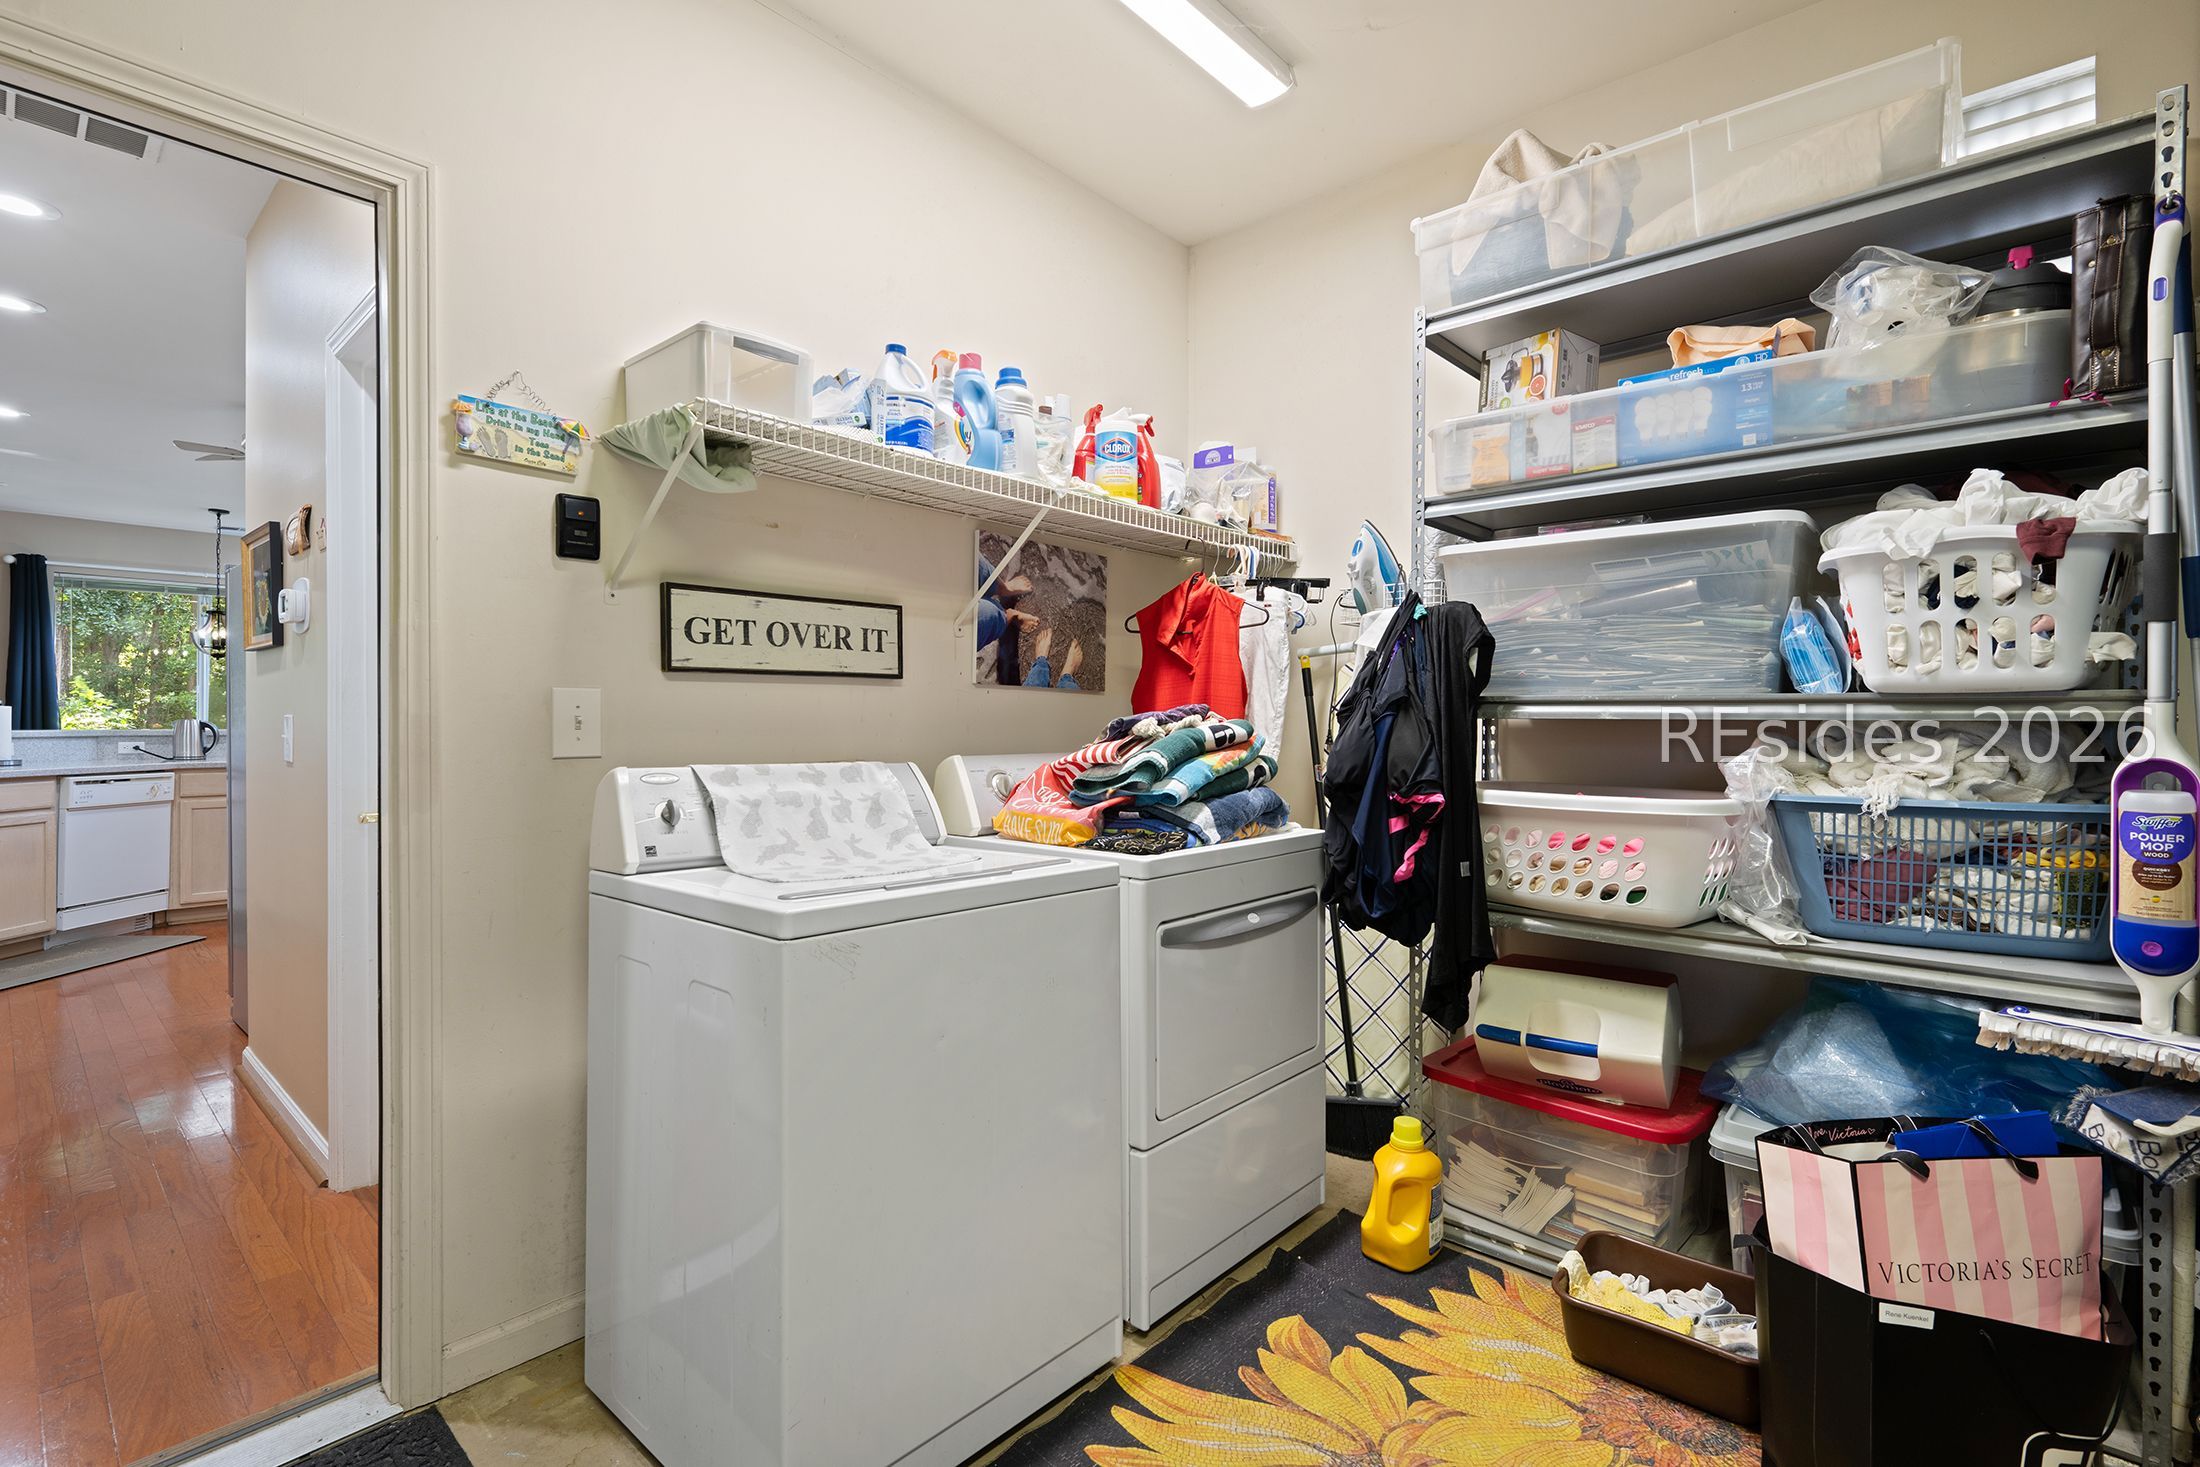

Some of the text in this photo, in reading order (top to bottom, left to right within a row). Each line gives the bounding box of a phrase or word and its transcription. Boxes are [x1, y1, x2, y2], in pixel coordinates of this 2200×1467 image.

[1104, 443, 1131, 454] CLOROX
[683, 616, 889, 653] GET OVER IT
[2131, 815, 2180, 830] Swiffer
[2129, 831, 2185, 843] POWER
[2140, 841, 2174, 852] MOP
[1828, 1125, 1867, 1141] Victoria
[1877, 1252, 2092, 1286] VICTORIA'S SECRET
